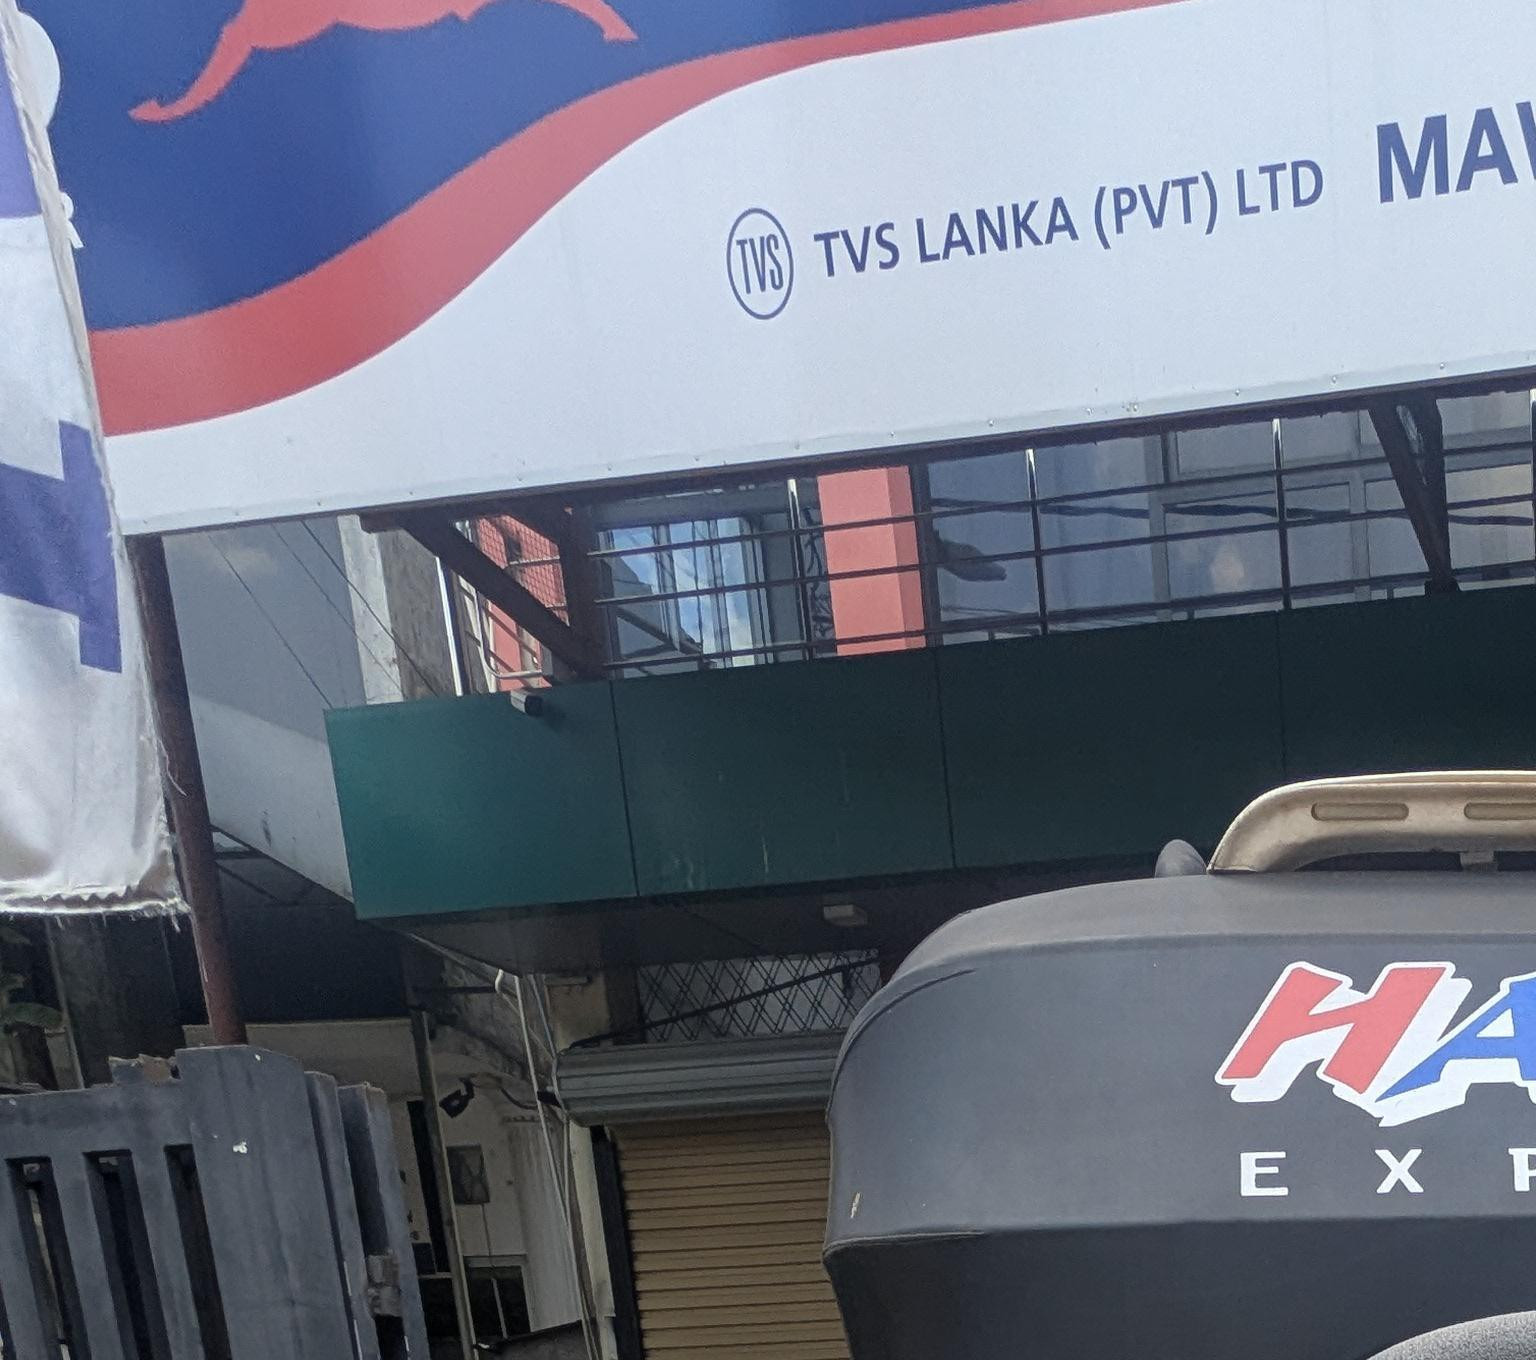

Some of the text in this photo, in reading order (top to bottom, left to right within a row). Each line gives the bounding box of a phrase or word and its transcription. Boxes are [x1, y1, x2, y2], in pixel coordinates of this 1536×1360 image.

[735, 158, 1324, 295] TVS TVS LANKA (PVT) LTD
